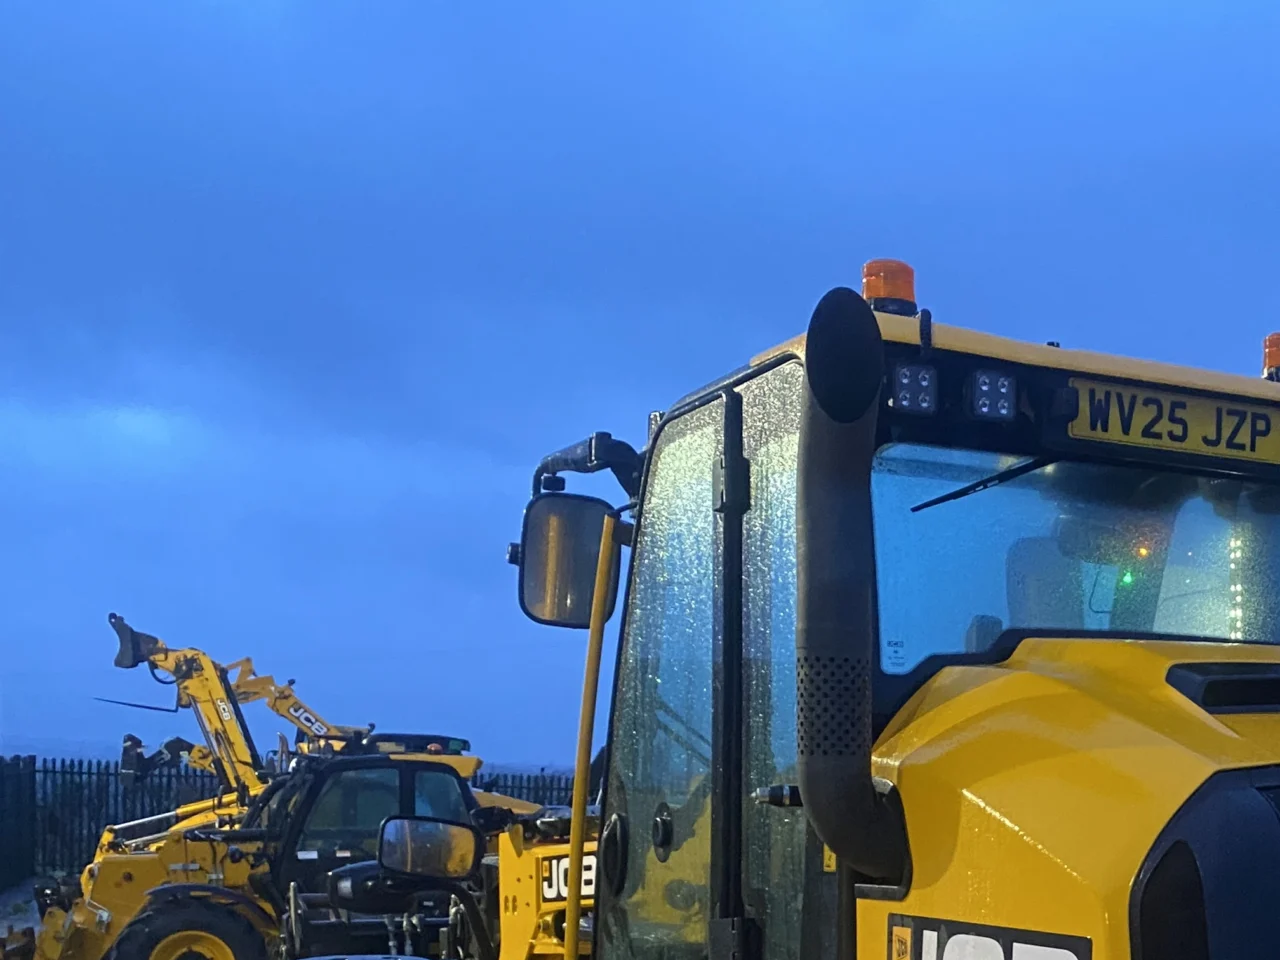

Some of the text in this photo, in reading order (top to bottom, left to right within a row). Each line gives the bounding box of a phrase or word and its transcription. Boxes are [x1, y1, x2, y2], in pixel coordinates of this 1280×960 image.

[1088, 387, 1272, 452] WV25 JZP
[217, 698, 231, 720] JCB
[289, 706, 328, 735] JCB
